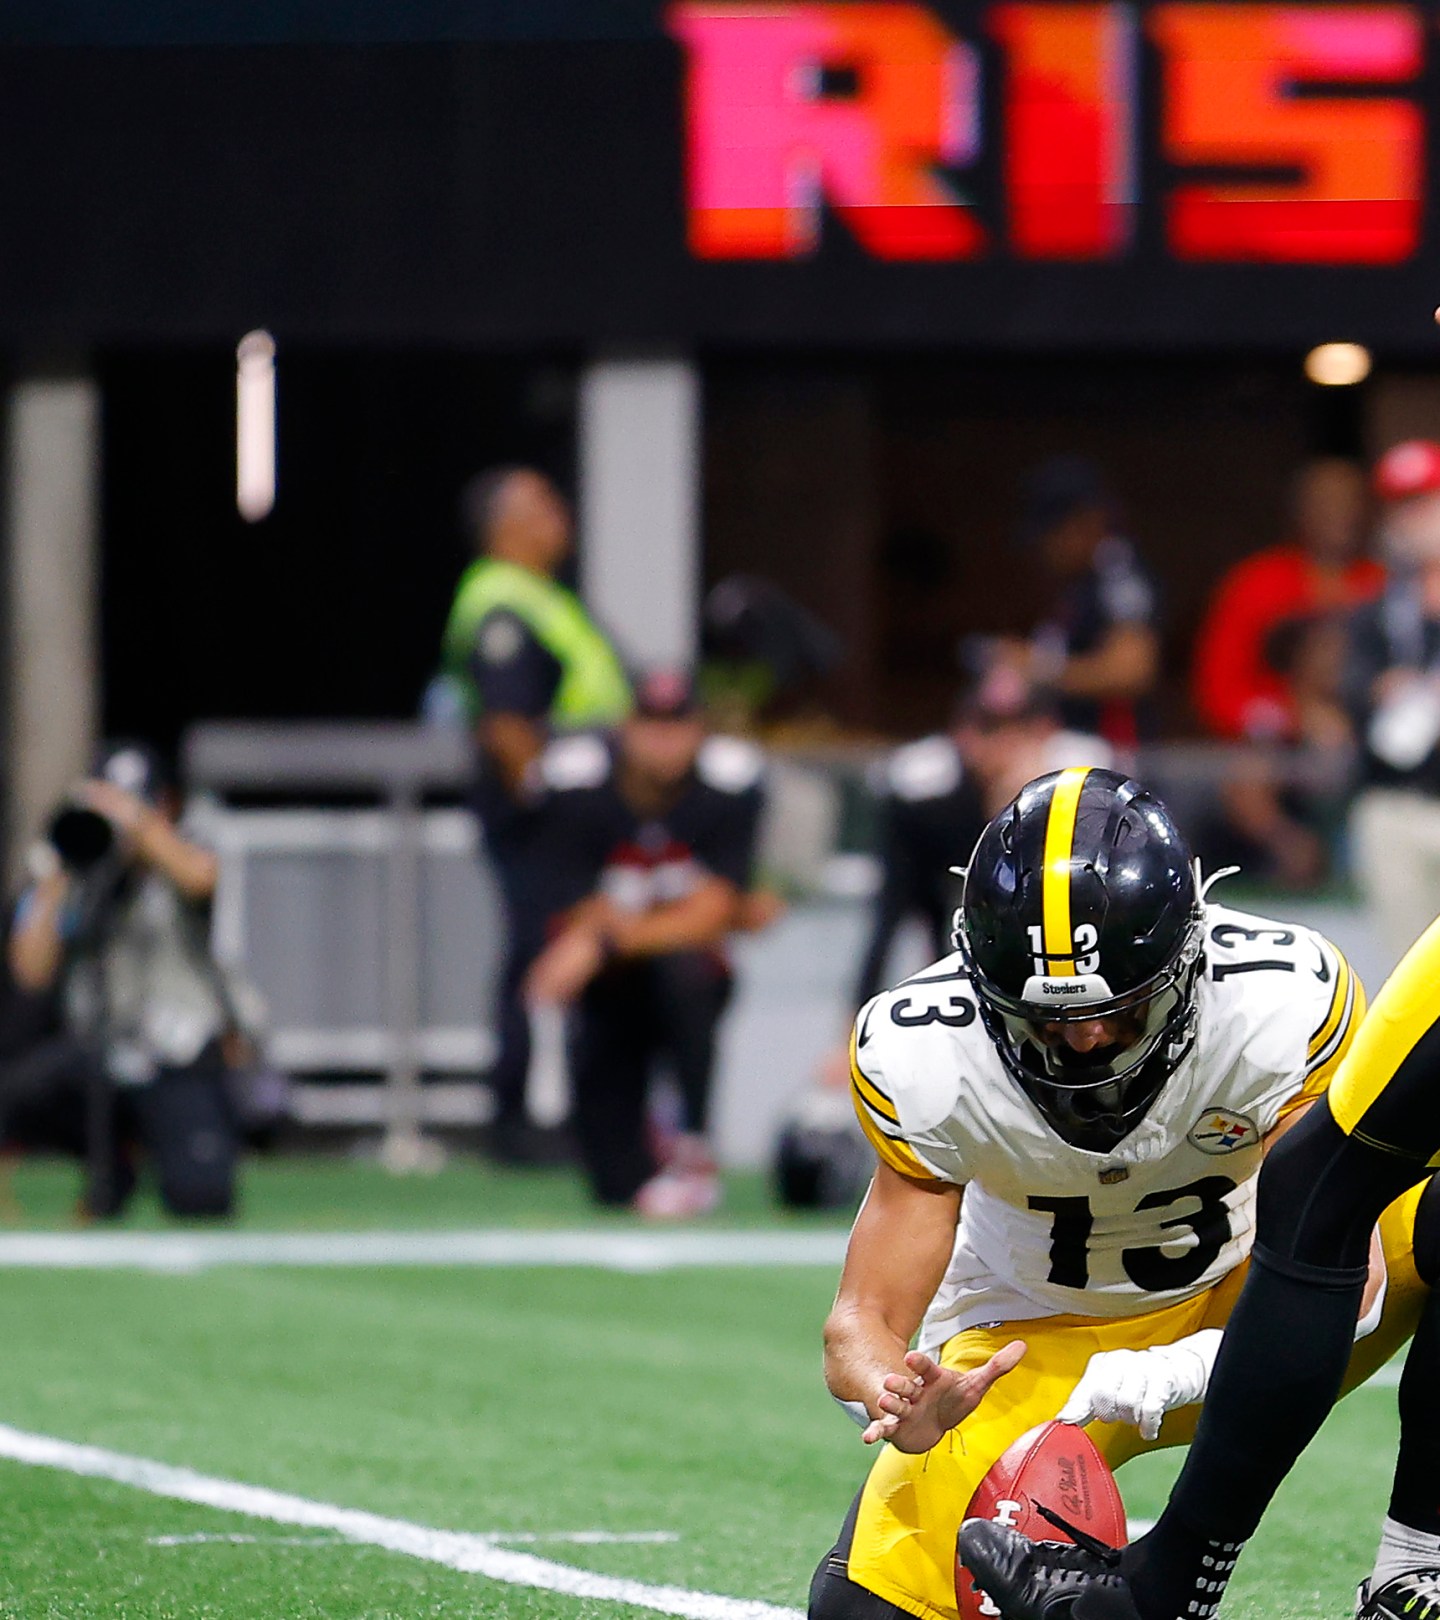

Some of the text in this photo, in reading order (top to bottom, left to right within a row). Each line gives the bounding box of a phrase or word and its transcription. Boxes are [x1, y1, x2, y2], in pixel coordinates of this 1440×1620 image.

[1026, 923, 1100, 975] 13
[1211, 924, 1296, 982] 13
[1042, 982, 1087, 995] Steelers
[1027, 1176, 1238, 1292] 13
